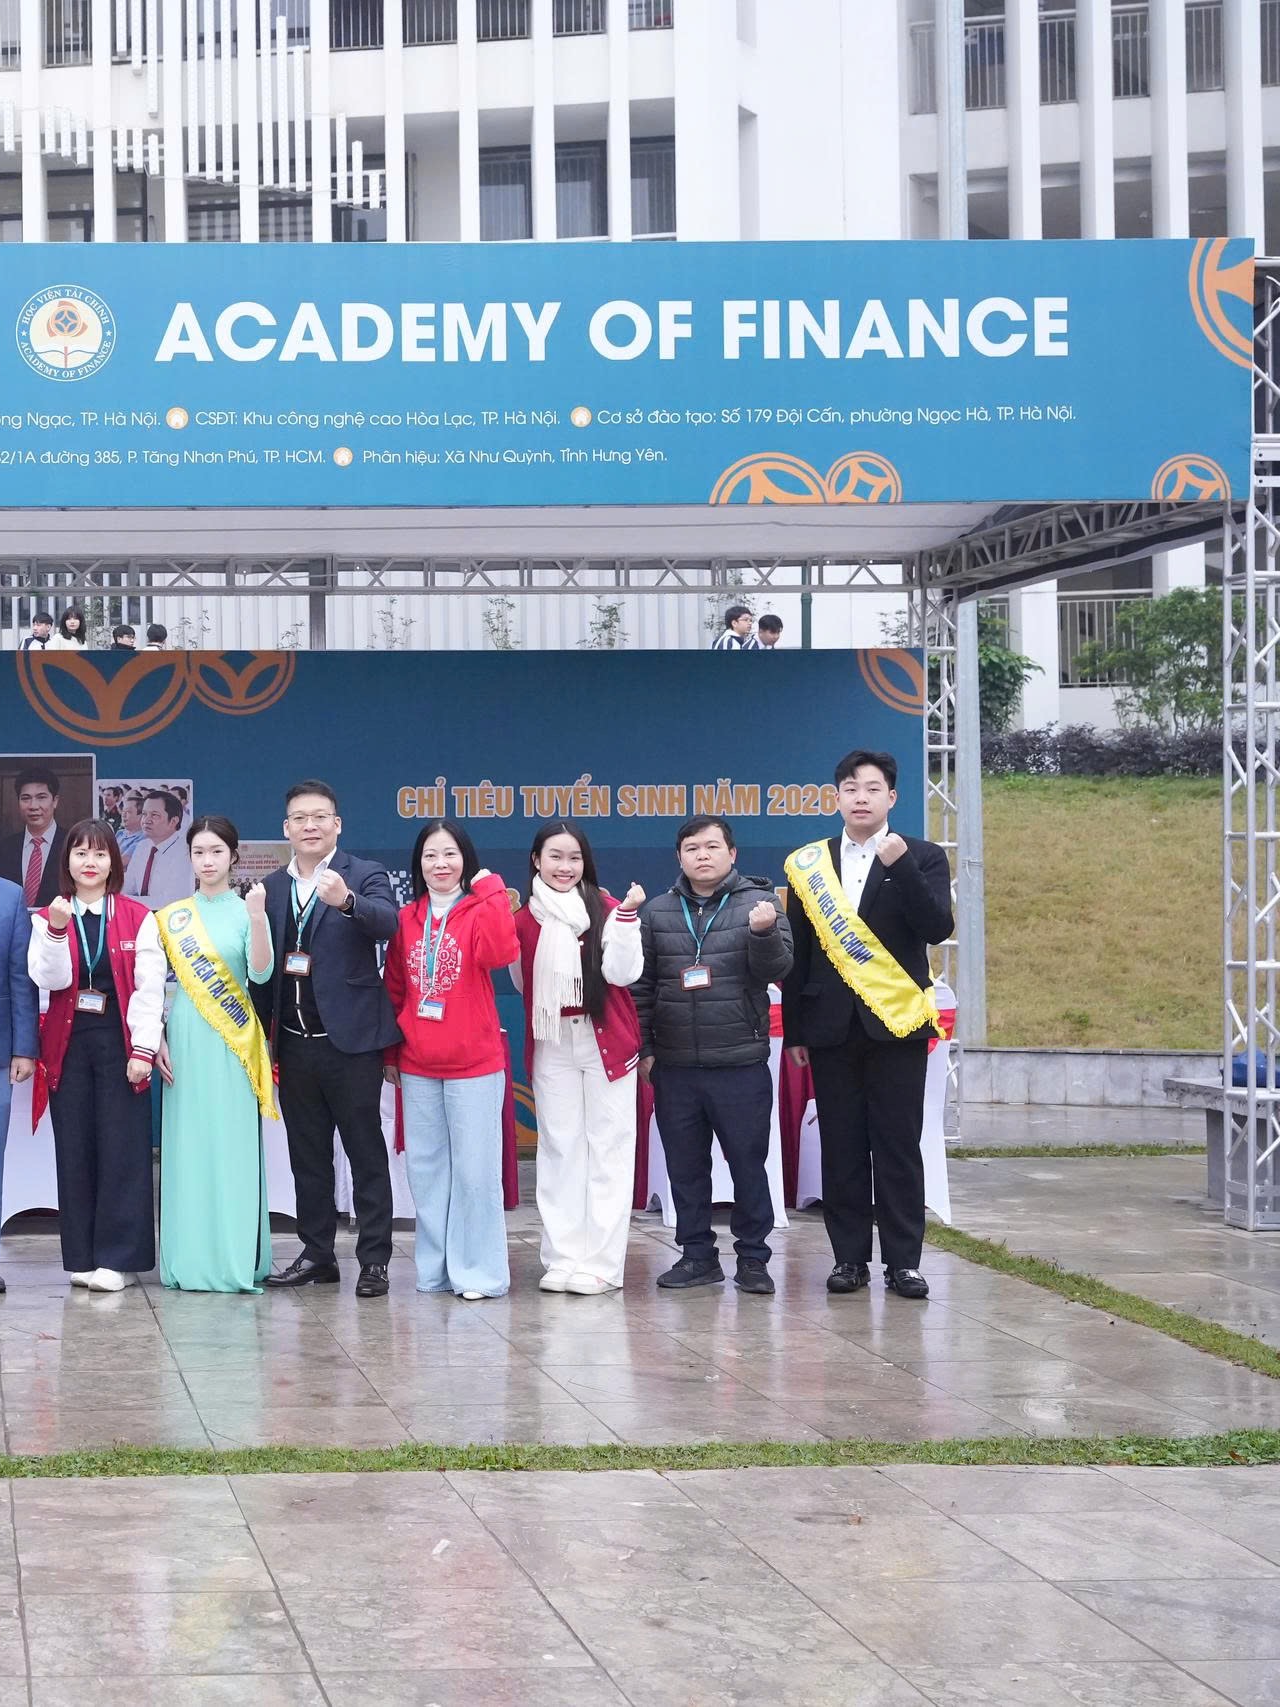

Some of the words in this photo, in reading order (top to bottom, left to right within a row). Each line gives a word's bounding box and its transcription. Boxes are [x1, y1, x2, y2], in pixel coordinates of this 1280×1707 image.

[155, 302, 561, 361] ACADEMY
[589, 300, 692, 360] OF
[723, 297, 1068, 359] FINANCE
[21, 341, 59, 376] ACADEMY
[61, 370, 76, 378] OF
[77, 341, 111, 376] FINANCE
[26, 411, 76, 430] Ngạc,
[79, 411, 99, 427] TP.
[103, 411, 127, 427] Hà
[131, 411, 161, 429] Nội.
[194, 411, 238, 426] CSĐT:
[243, 411, 273, 426] Khu
[276, 410, 320, 429] công
[323, 411, 366, 429] nghệ
[369, 414, 402, 426] cao
[406, 411, 440, 426] Hòa
[443, 411, 476, 429] Lạc,
[480, 411, 499, 425] TP.
[504, 410, 527, 425] Hà
[530, 410, 561, 428] Nội.
[596, 409, 622, 425] Cơ
[625, 407, 644, 424] sở
[647, 409, 682, 424] đào
[684, 409, 717, 427] tạo:
[720, 407, 741, 424] Số
[745, 408, 773, 424] 179
[775, 408, 803, 426] Đội
[806, 406, 845, 424] Cấn,
[849, 407, 913, 426] phường
[917, 407, 962, 425] Ngọc
[965, 406, 992, 422] Hà,
[996, 406, 1015, 421] TP.
[1019, 405, 1043, 421] Hà
[1046, 404, 1077, 423] Nội.
[39, 450, 90, 467] đường
[93, 450, 123, 465] 385,
[127, 450, 138, 464] P.
[141, 450, 180, 467] Tăng
[183, 449, 224, 464] Nhơn
[227, 449, 259, 465] Phú,
[263, 448, 281, 464] TP.
[284, 449, 326, 464] HCM.
[362, 449, 402, 464] Phân
[404, 449, 441, 467] hiệu:
[444, 449, 465, 464] Xã
[468, 449, 500, 464] Như
[502, 448, 556, 466] Quỳnh,
[559, 447, 589, 463] Tỉnh
[592, 448, 632, 465] Hưng
[634, 447, 668, 462] Yên.
[397, 776, 446, 818] CHỈ
[452, 779, 514, 818] TIÊU
[520, 773, 610, 817] TUYỂN
[617, 784, 686, 816] SINH
[693, 778, 761, 816] NĂM
[767, 784, 838, 816] 2026
[807, 871, 826, 895] HỌC
[817, 892, 837, 920] VIỆN
[829, 913, 849, 936] TÀI
[840, 931, 875, 966] CHÍNH
[178, 934, 200, 958] HỌC
[190, 953, 216, 983] VIỆN
[207, 975, 227, 1000] TÀI
[220, 994, 249, 1029] CHÍNH
